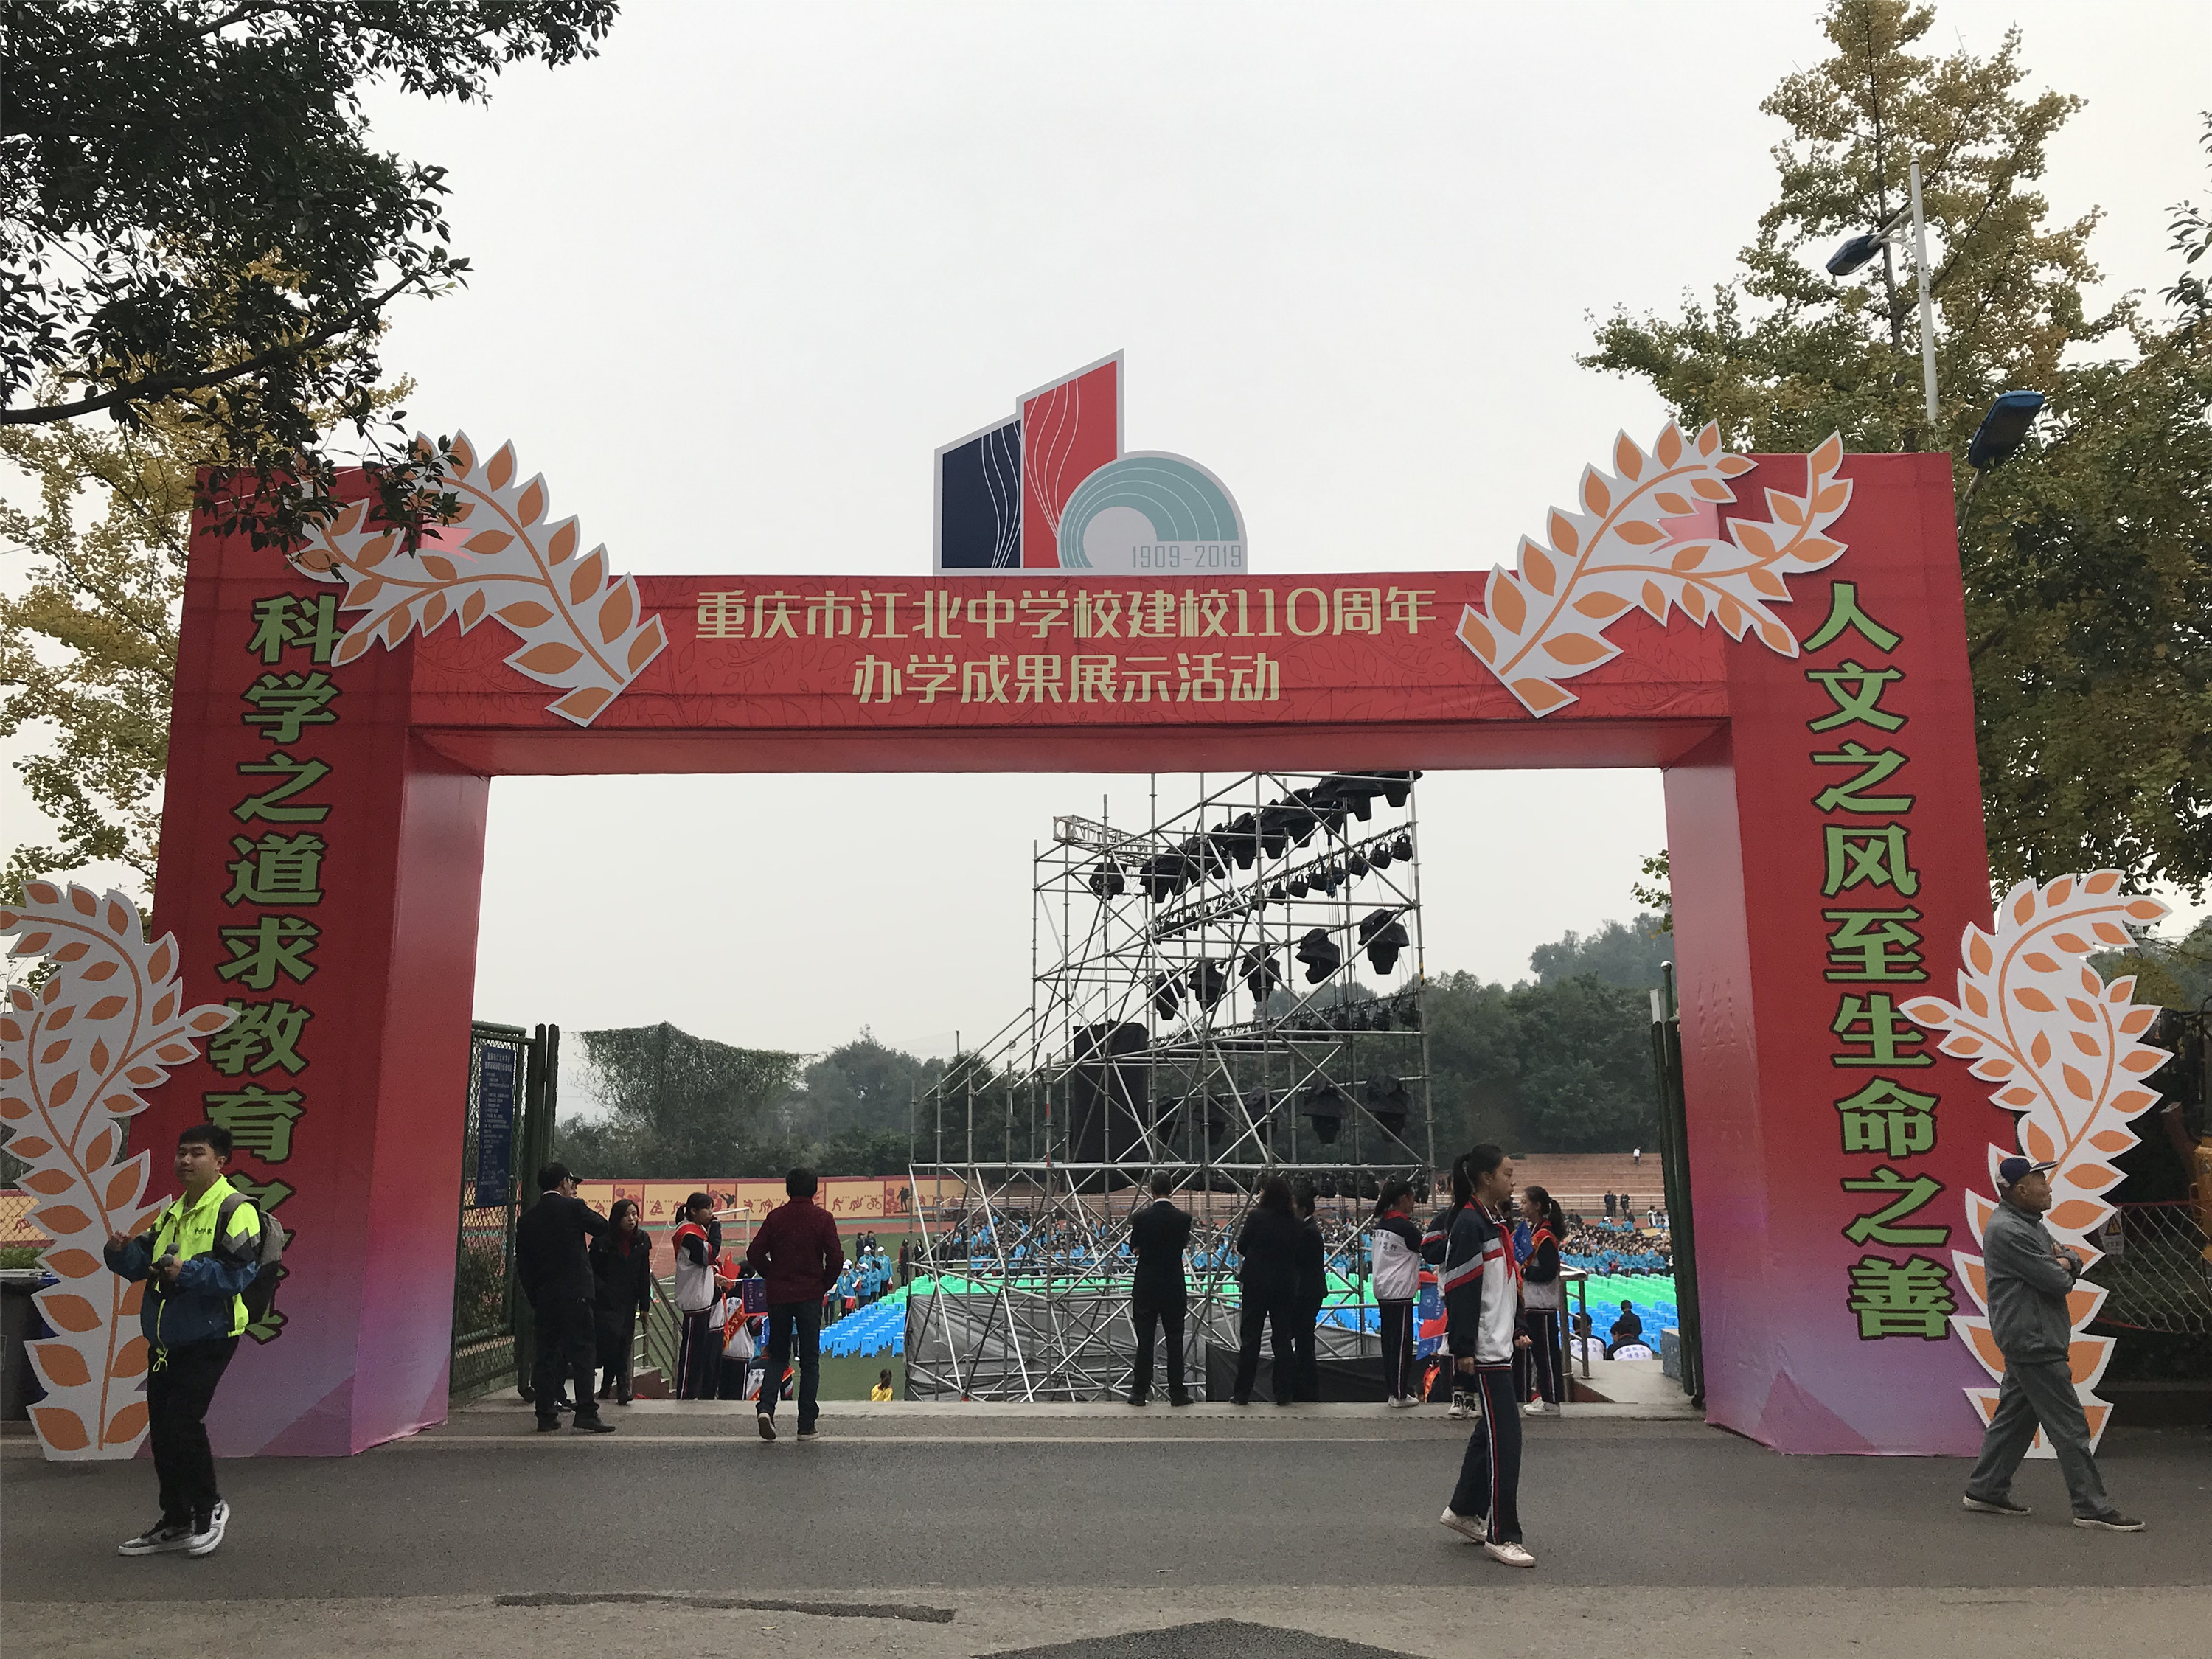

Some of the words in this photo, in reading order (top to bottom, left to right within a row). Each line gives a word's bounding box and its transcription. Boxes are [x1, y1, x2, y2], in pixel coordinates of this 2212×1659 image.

[1133, 545, 1242, 568] 1909-2019
[695, 587, 1437, 639] 重庆市江北中学校建校110周年
[852, 652, 1280, 704] 办学成果展示活动
[204, 592, 344, 1343] 科学之道求教育
[1801, 580, 1958, 1340] 人文之风至生命之善
